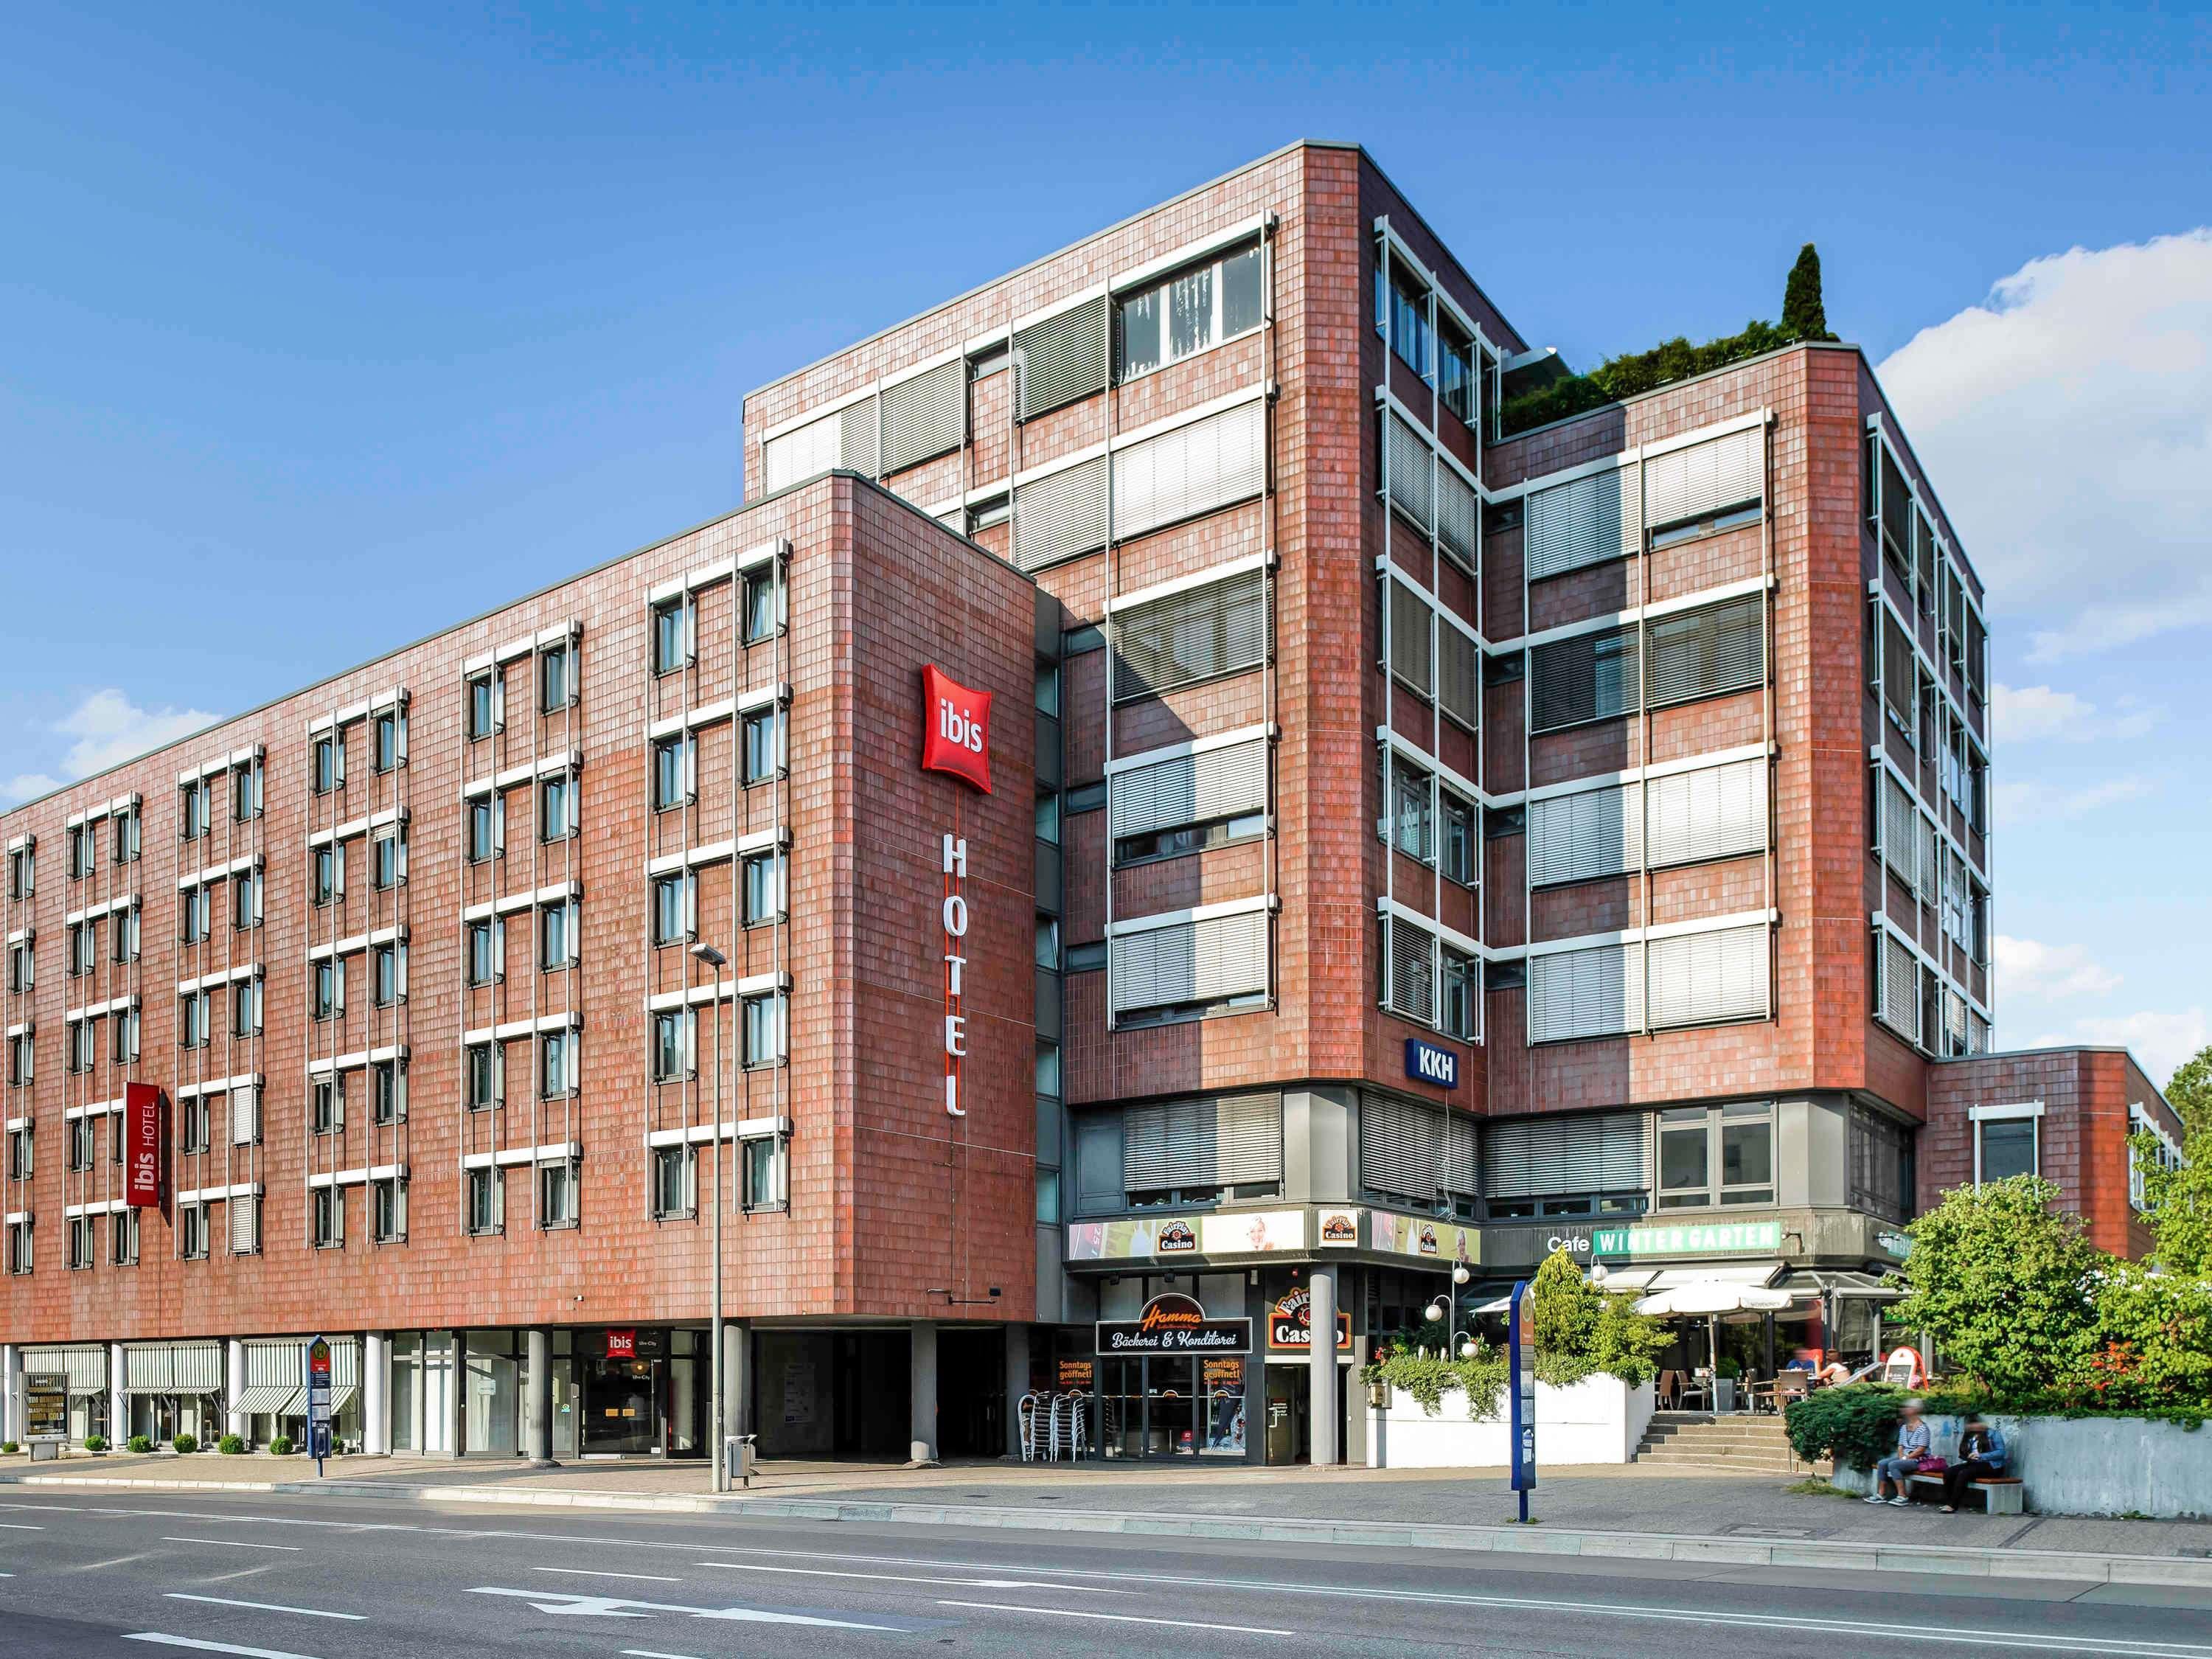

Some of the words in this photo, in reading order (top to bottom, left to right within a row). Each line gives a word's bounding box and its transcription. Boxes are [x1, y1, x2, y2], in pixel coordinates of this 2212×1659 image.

[940, 698, 983, 753] ibis
[943, 834, 967, 1115] HOTEL
[1419, 1046, 1453, 1082] KKH
[142, 1102, 155, 1147] HOTEL
[134, 1152, 154, 1191] ibis
[1325, 1231, 1354, 1239] Casino
[1548, 1236, 1590, 1252] Cafe
[1161, 1239, 1193, 1250] Casino
[1141, 1304, 1202, 1332] Hamma
[609, 1335, 632, 1349] ibis
[1112, 1332, 1159, 1348] Bäckerei
[1162, 1331, 1175, 1347] &
[1177, 1330, 1237, 1346] Konditorei
[1059, 1360, 1092, 1371] Sonntags
[1203, 1360, 1239, 1370] Sonntags
